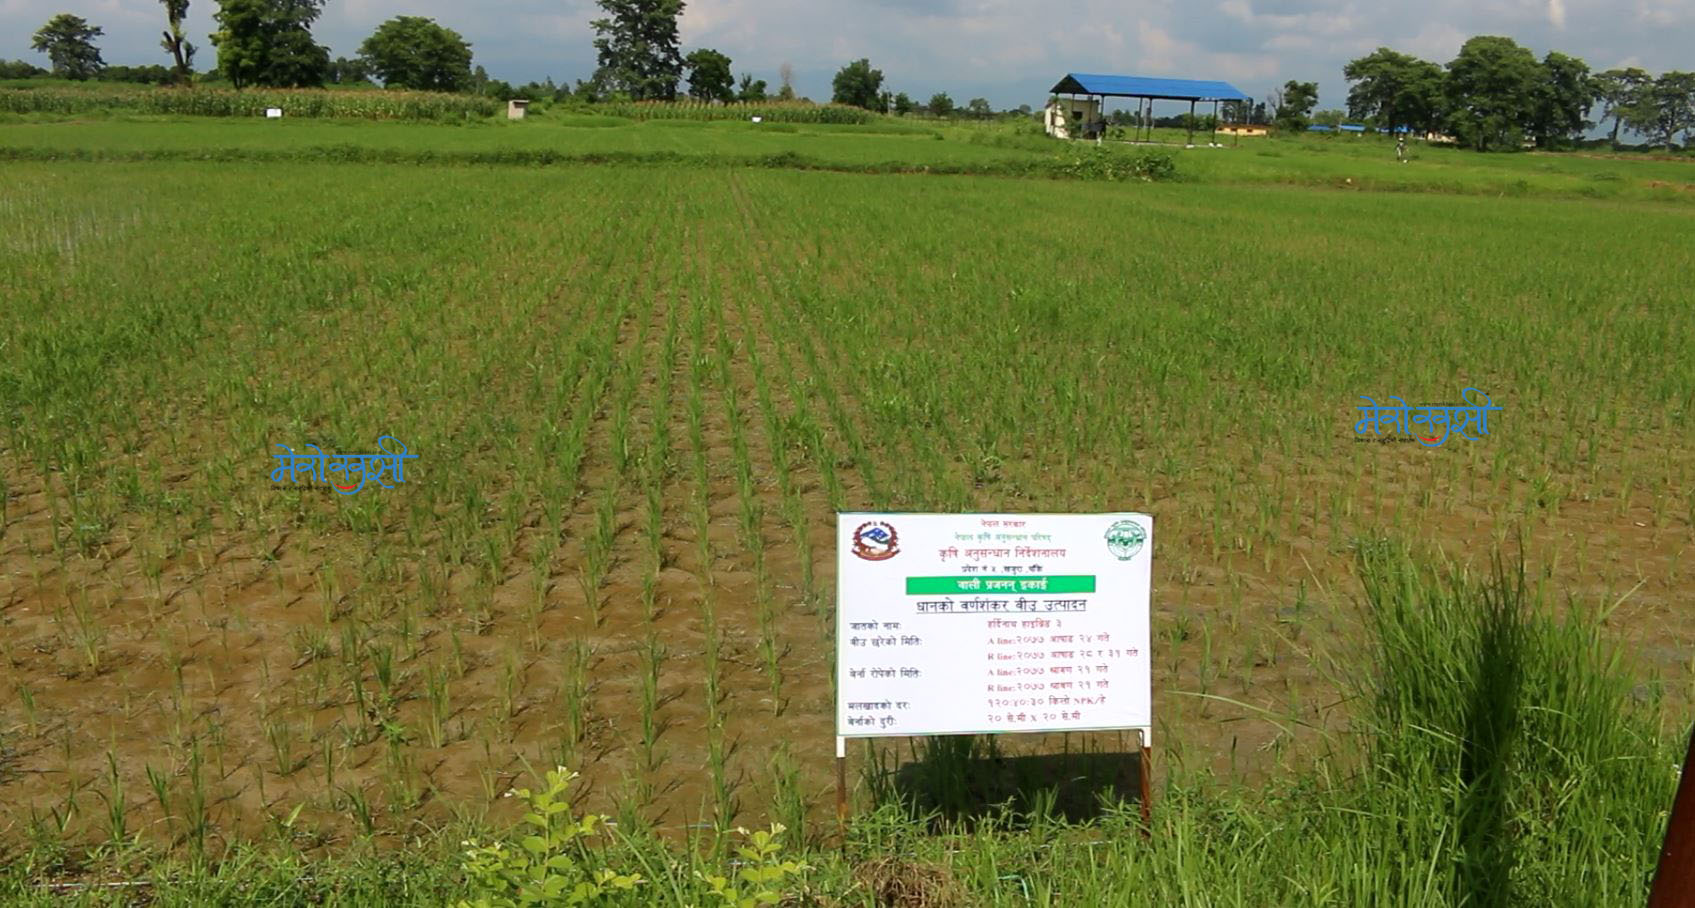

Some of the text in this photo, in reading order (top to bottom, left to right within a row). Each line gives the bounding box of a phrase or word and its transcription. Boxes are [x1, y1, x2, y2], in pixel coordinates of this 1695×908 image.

[939, 545, 1066, 562] कृषि अनुसन्धान निर्देशनालय
[916, 597, 954, 612] धानको
[1043, 599, 1087, 611] उत्पादन
